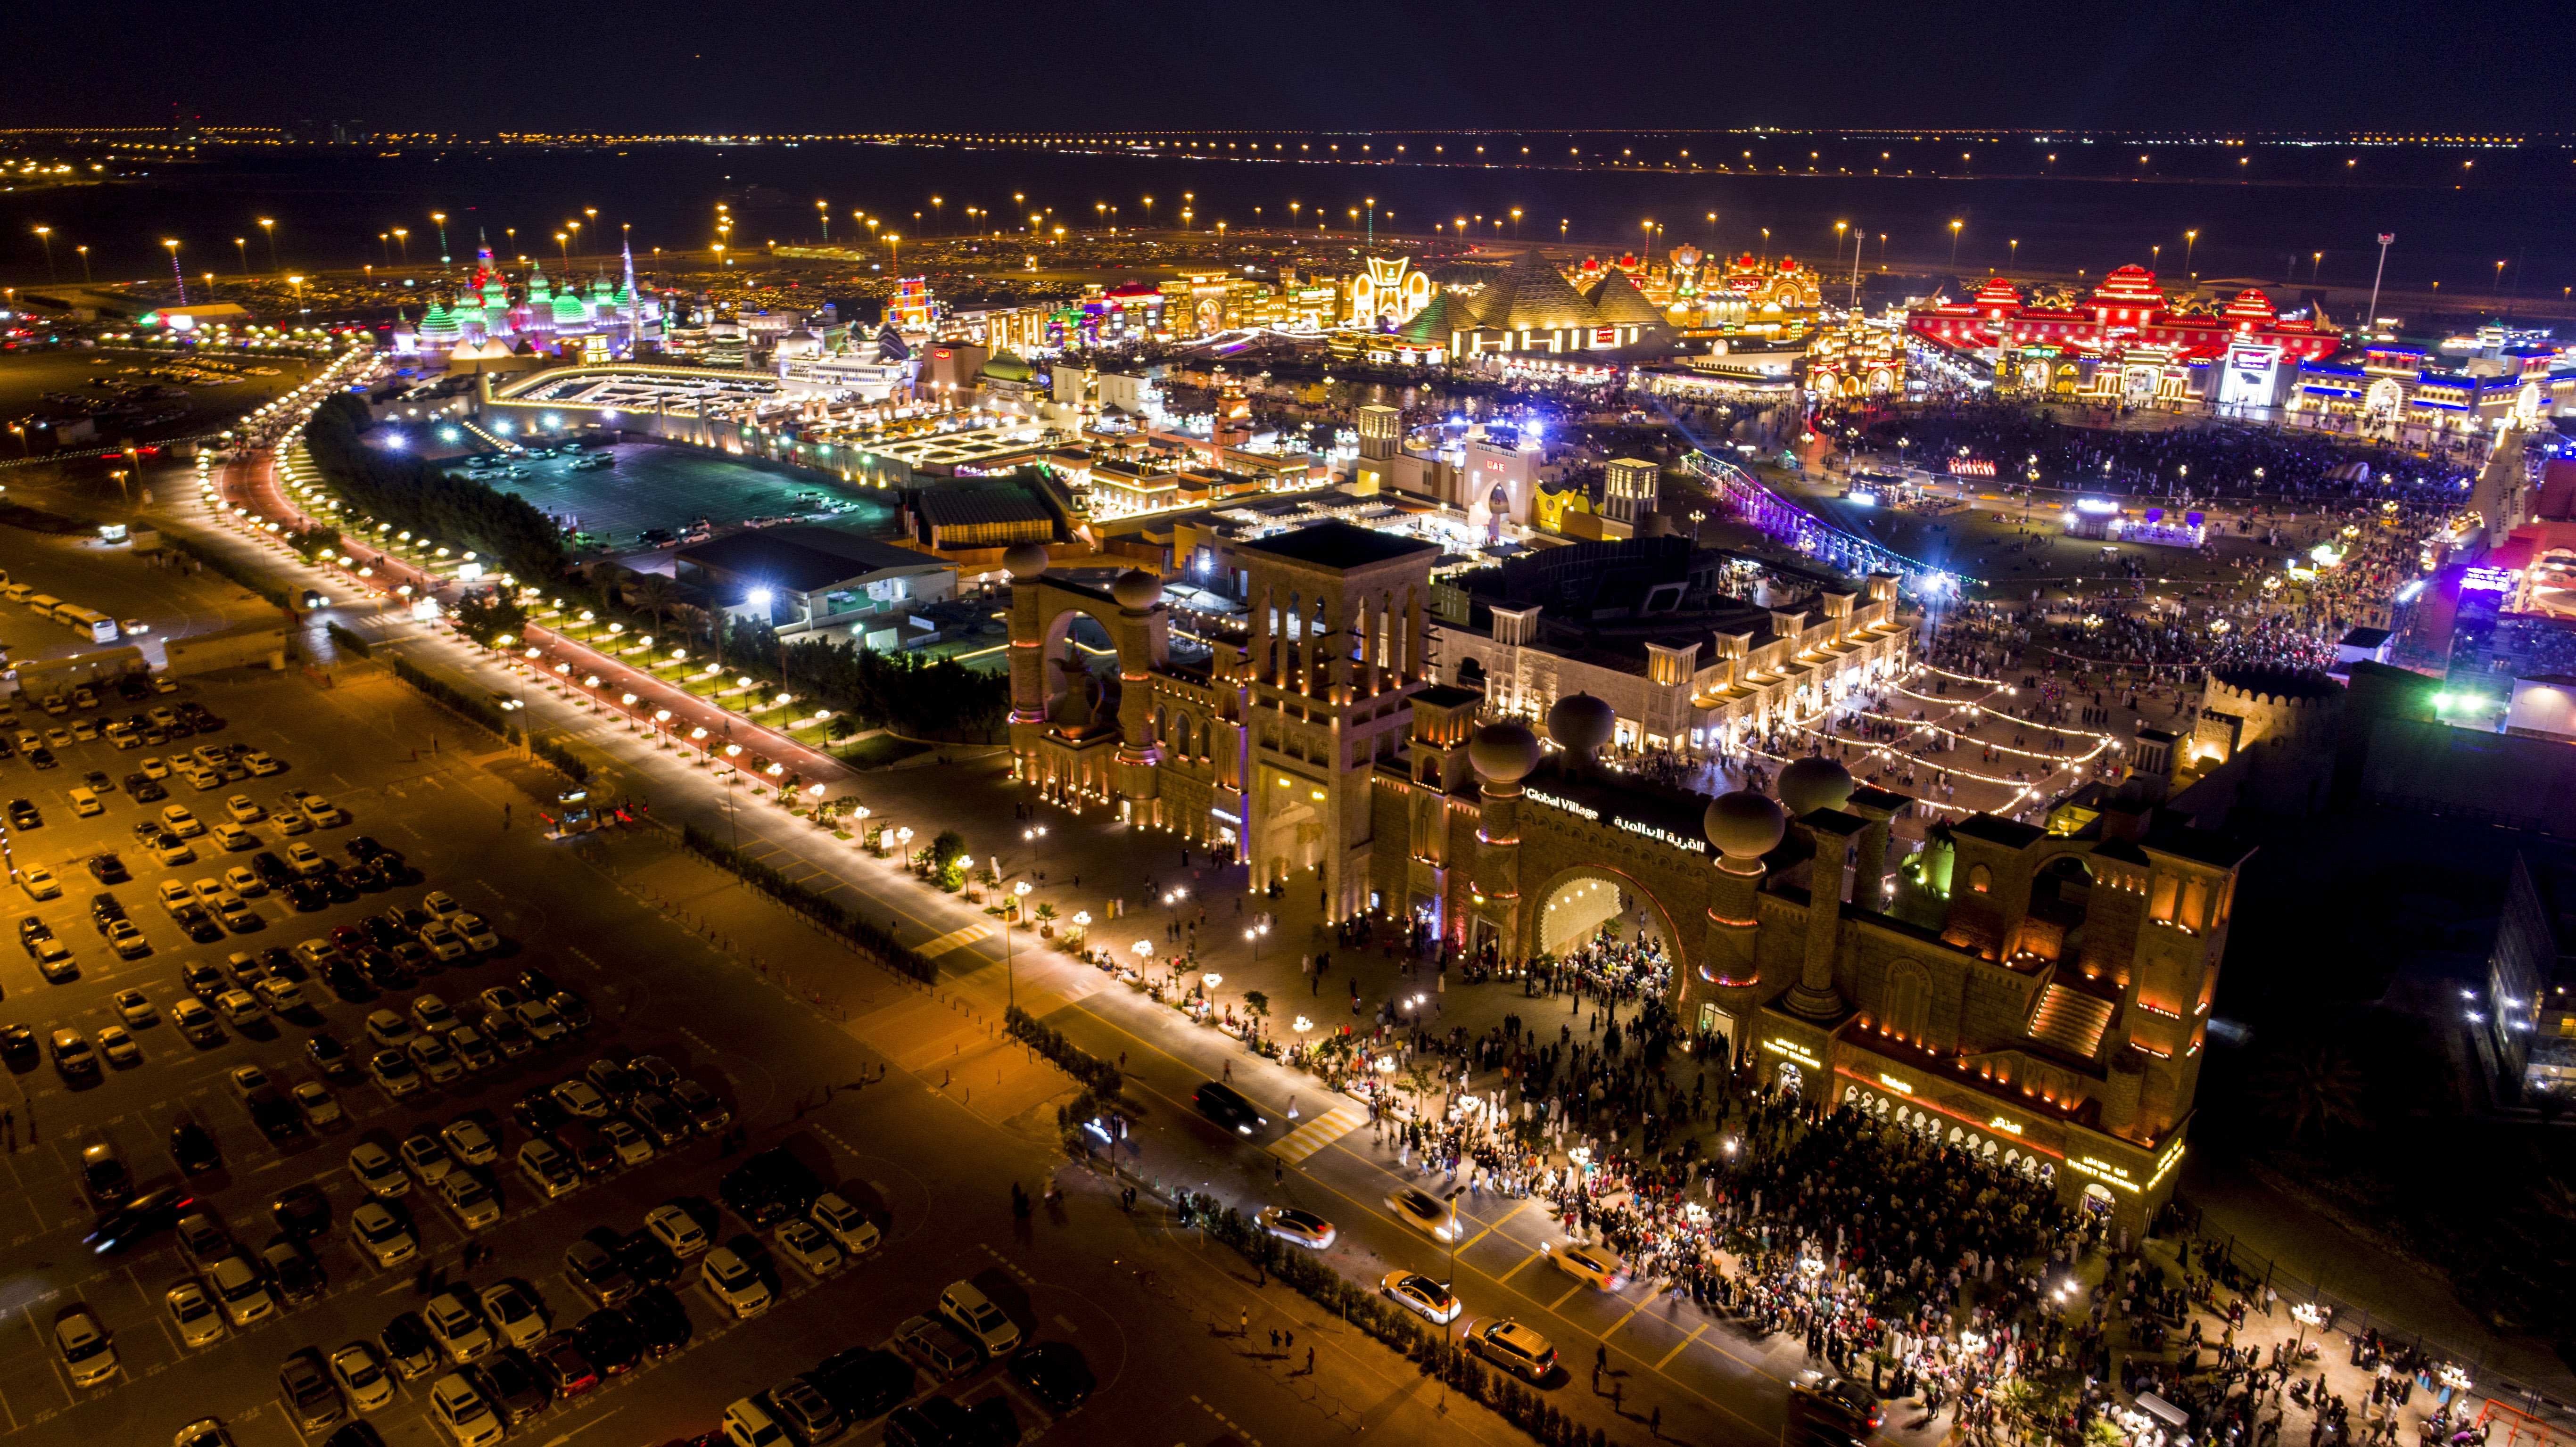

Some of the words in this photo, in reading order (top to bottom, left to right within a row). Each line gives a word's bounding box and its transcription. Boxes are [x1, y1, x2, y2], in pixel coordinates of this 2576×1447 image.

[1486, 460, 1505, 472] UAE
[1527, 788, 1560, 808] Global
[1560, 798, 1599, 820] Village
[1614, 816, 1665, 840] العالمية
[1667, 832, 1705, 853] القرية
[1764, 1041, 1788, 1055] TICKET
[1789, 1051, 1821, 1069] MACHINE
[2067, 1159, 2098, 1176] TICKET
[2099, 1171, 2140, 1193] MACHINE
